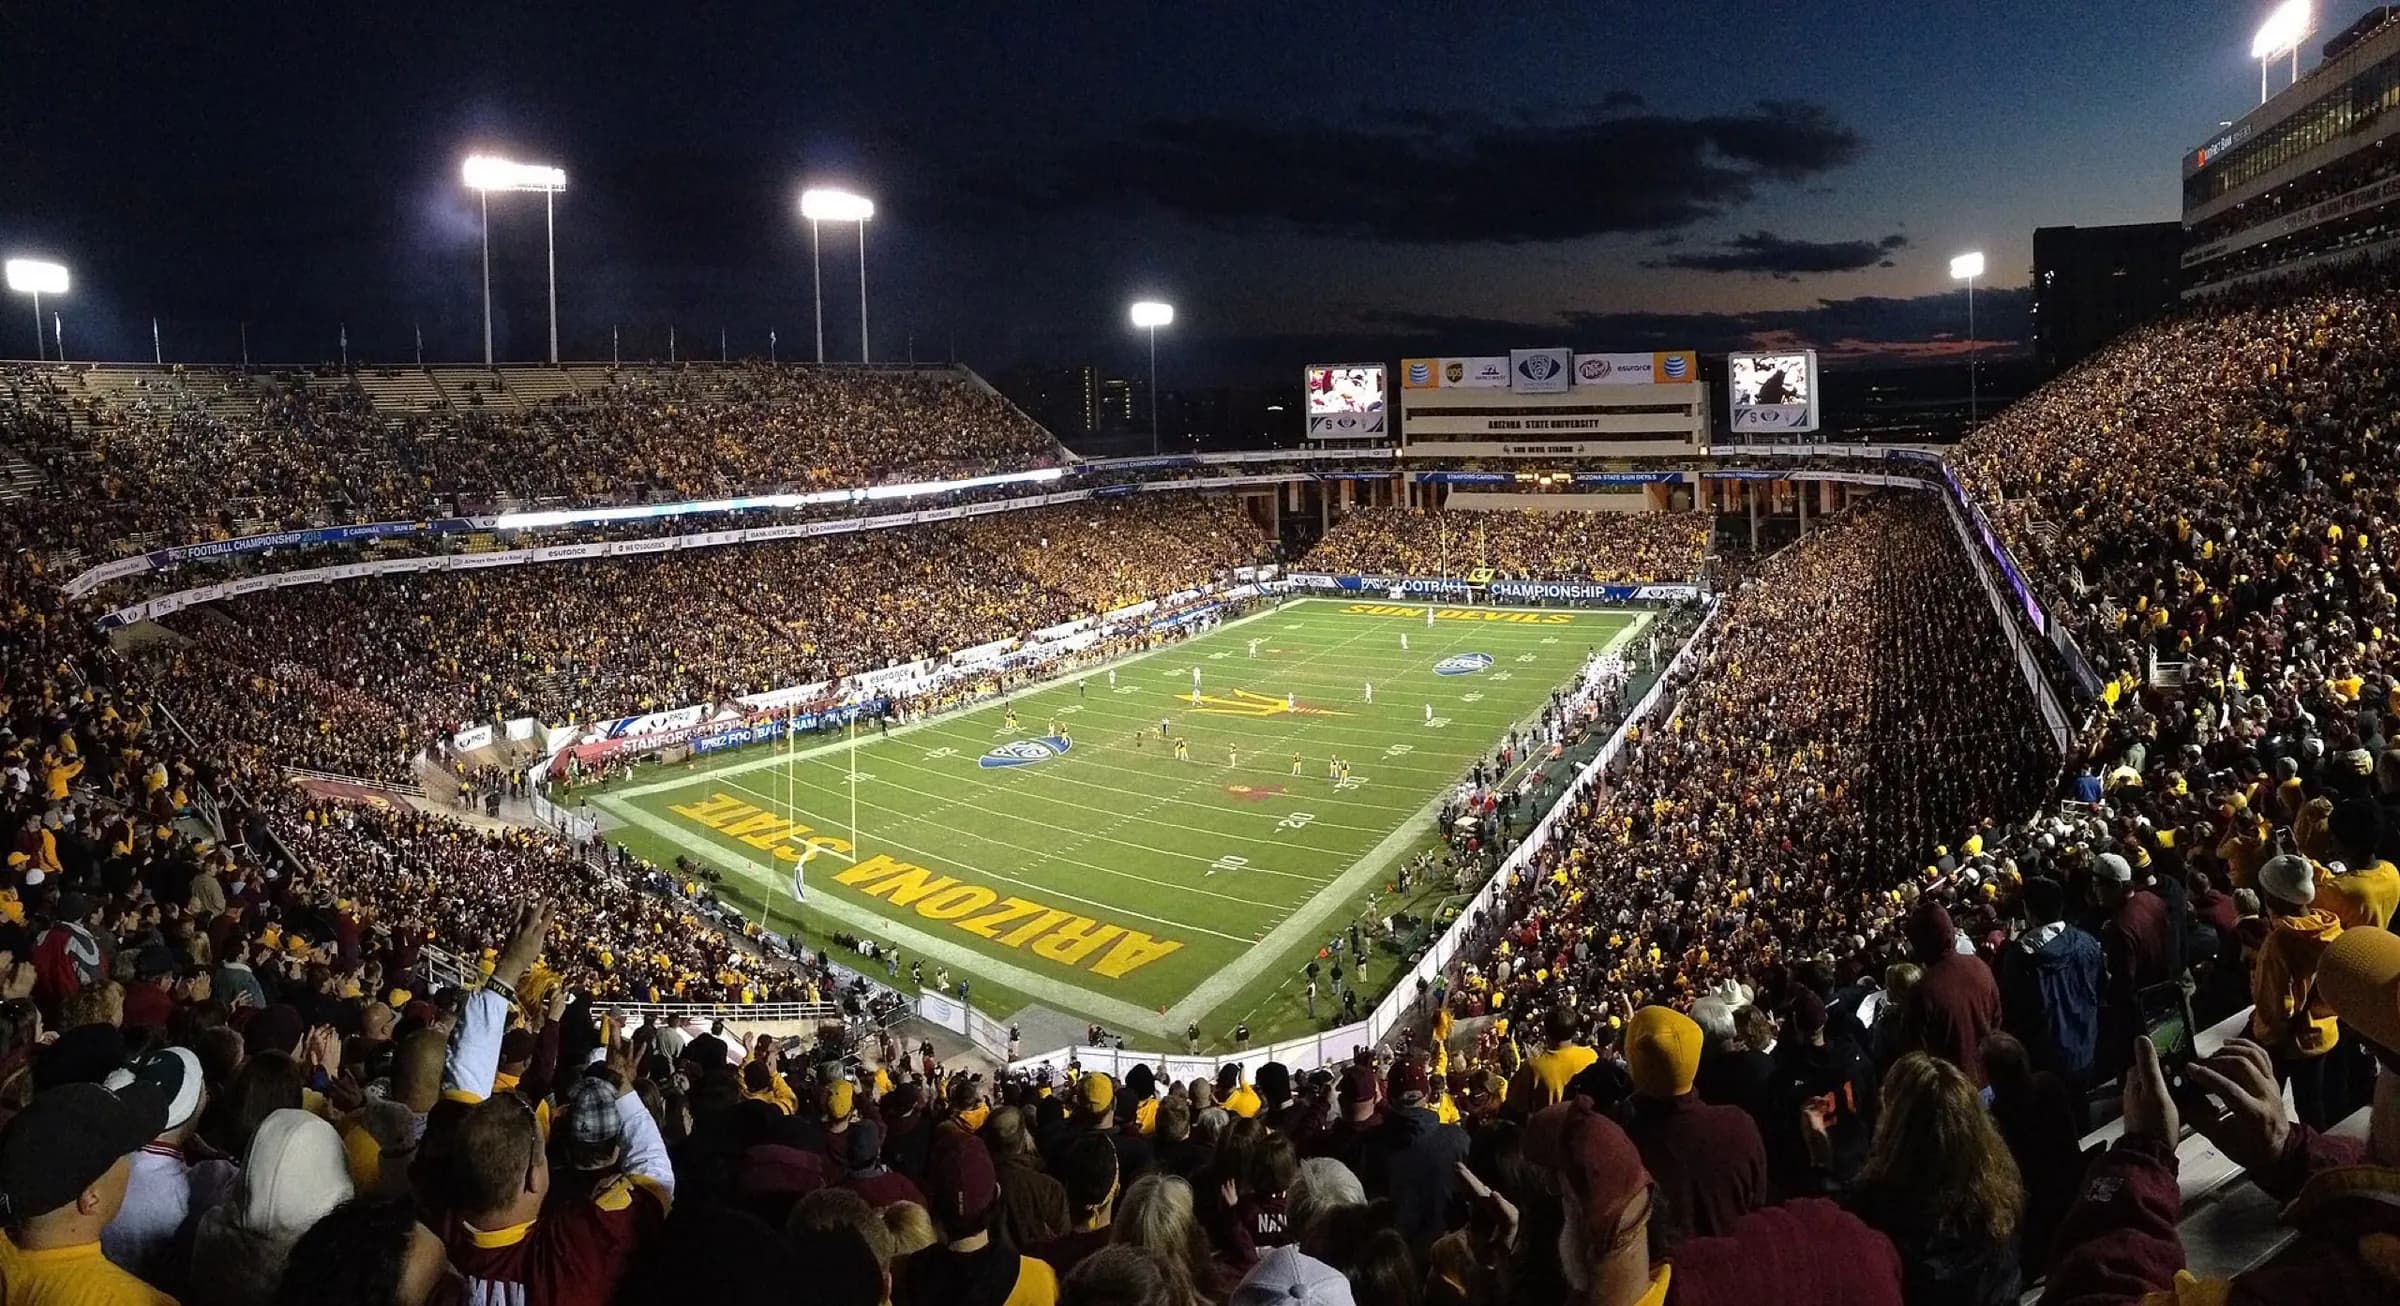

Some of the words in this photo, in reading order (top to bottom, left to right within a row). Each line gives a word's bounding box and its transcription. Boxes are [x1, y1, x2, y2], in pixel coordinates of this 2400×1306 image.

[1325, 420, 1332, 430] S
[1488, 420, 1520, 429] ARIZONA
[1525, 420, 1549, 429] STATE
[1550, 419, 1599, 428] UNIVERSITY
[188, 543, 232, 558] FOOTBALL
[233, 533, 301, 550] CHAMPIONSHIP
[301, 531, 322, 542] 2013
[548, 547, 586, 557] esurance
[235, 581, 263, 591] esurance
[1404, 578, 1463, 593] OOTBALL
[1491, 584, 1605, 598] CHAMPIONSHIP
[1340, 604, 1427, 617] SUN
[1434, 609, 1576, 624] DEVILS
[869, 670, 910, 684] esurance
[728, 722, 784, 745] FOOBALL
[1278, 812, 1315, 828] 20
[1211, 856, 1248, 871] 10
[667, 792, 852, 862] STATE
[831, 854, 1185, 979] ARIZONA
